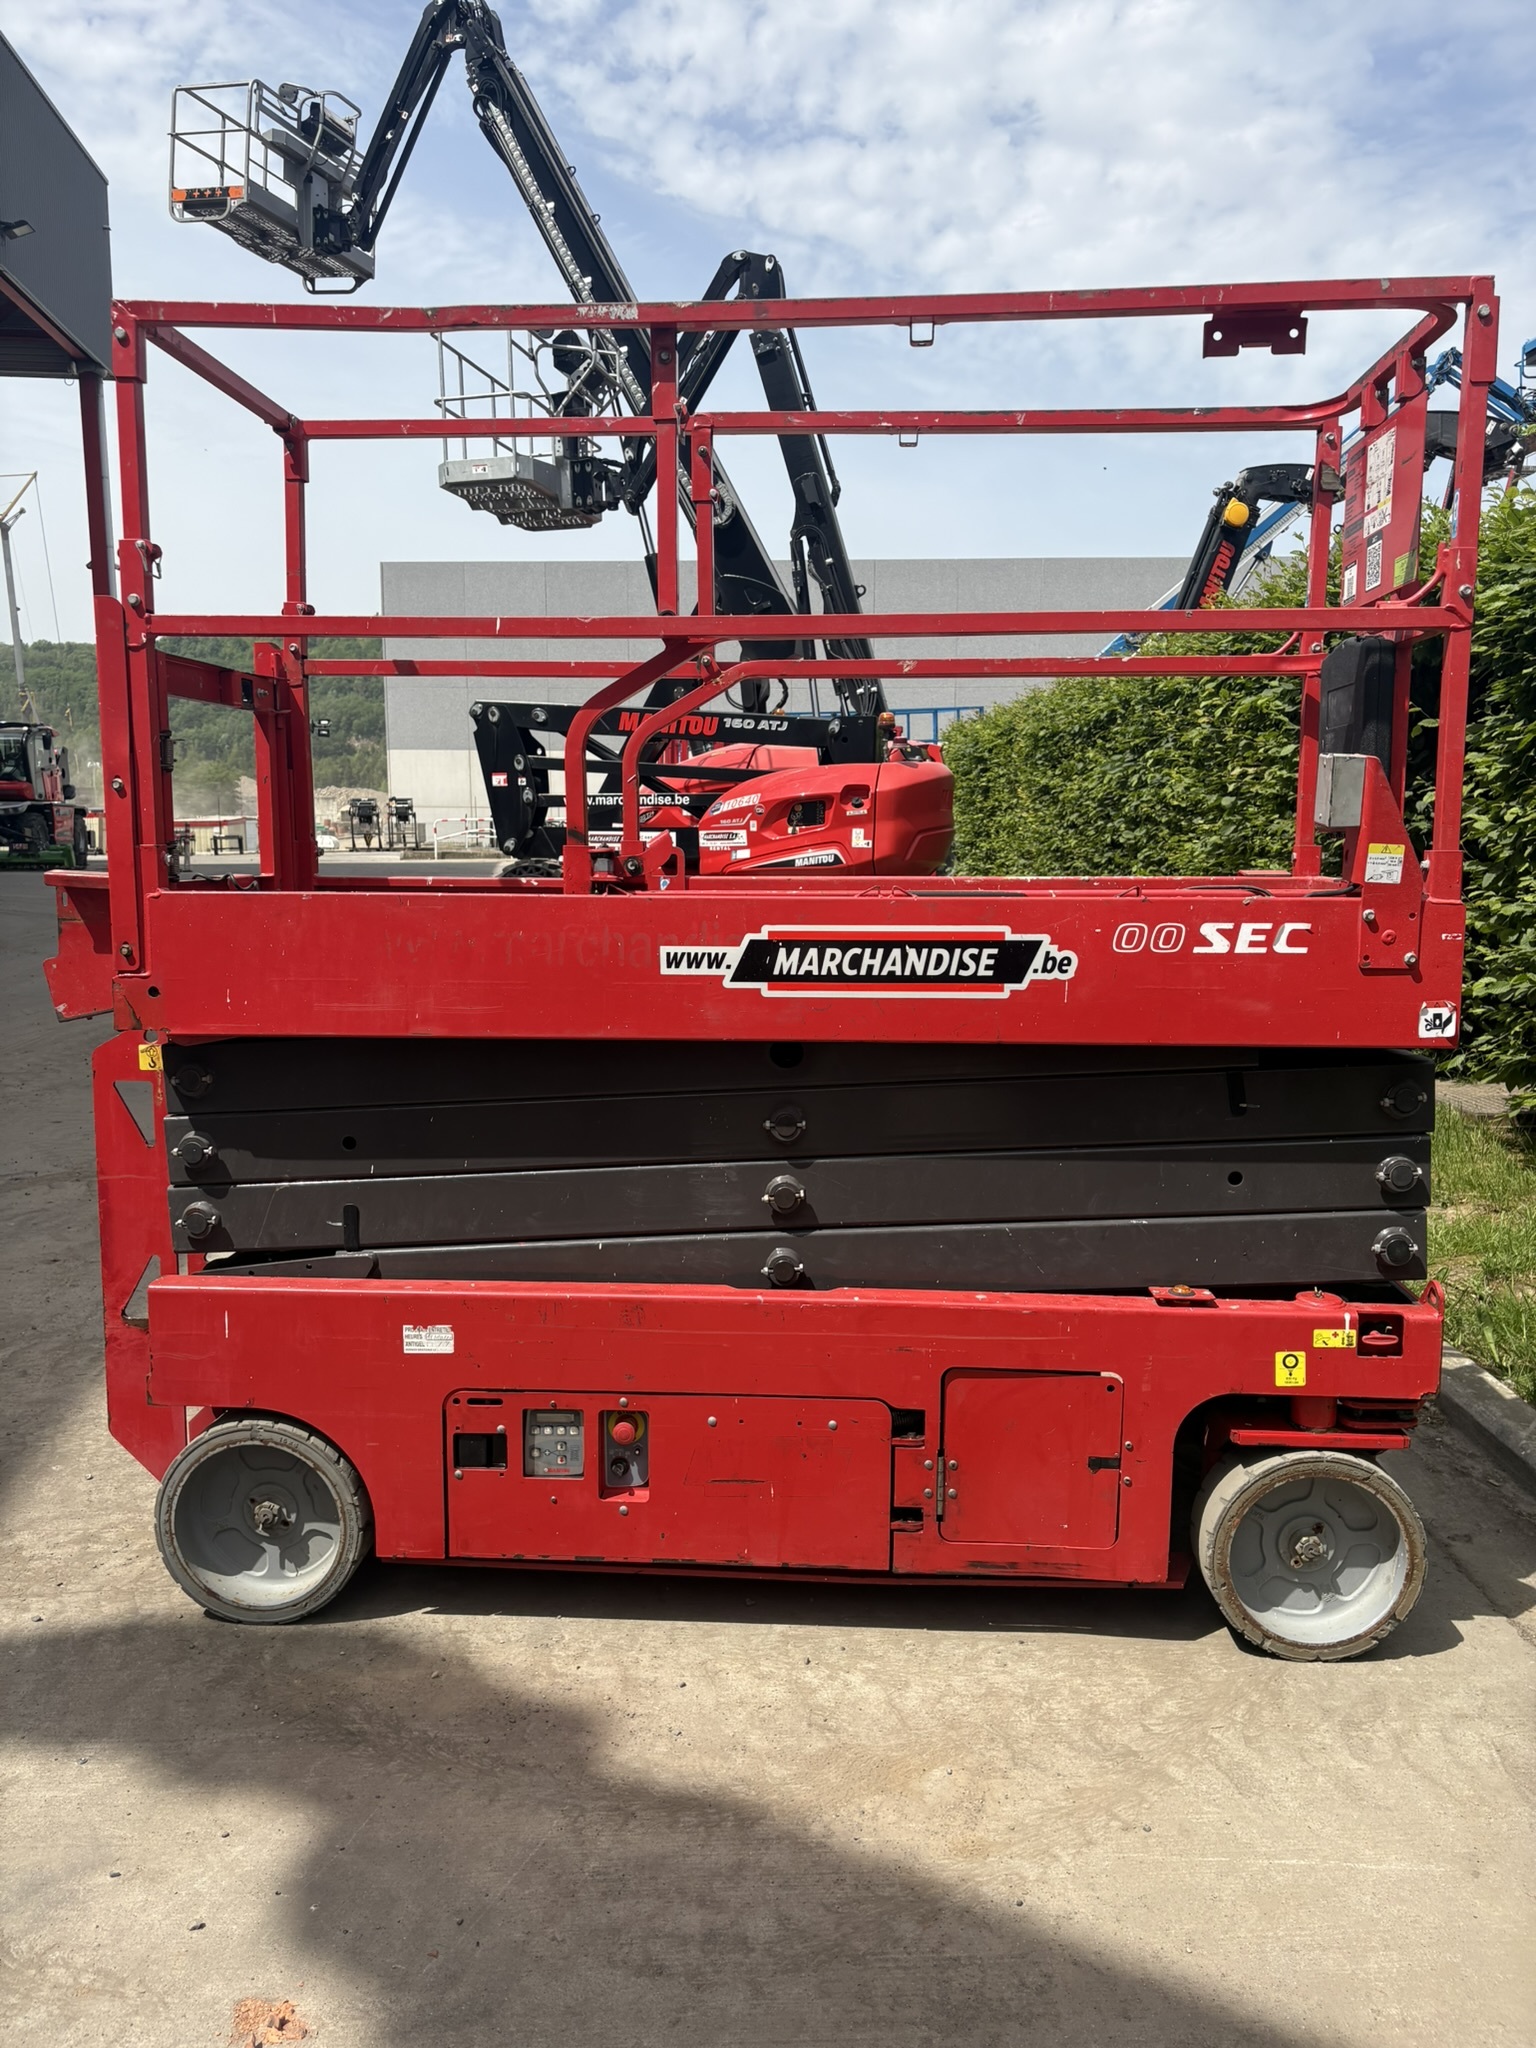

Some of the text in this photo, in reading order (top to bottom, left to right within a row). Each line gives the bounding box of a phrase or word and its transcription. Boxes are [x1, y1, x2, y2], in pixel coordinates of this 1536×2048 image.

[618, 711, 788, 736] MITOU 160 ATJ
[795, 854, 834, 867] MANITOU
[1112, 922, 1312, 954] 00 SEC
[772, 947, 998, 977] MARCHANDISE
